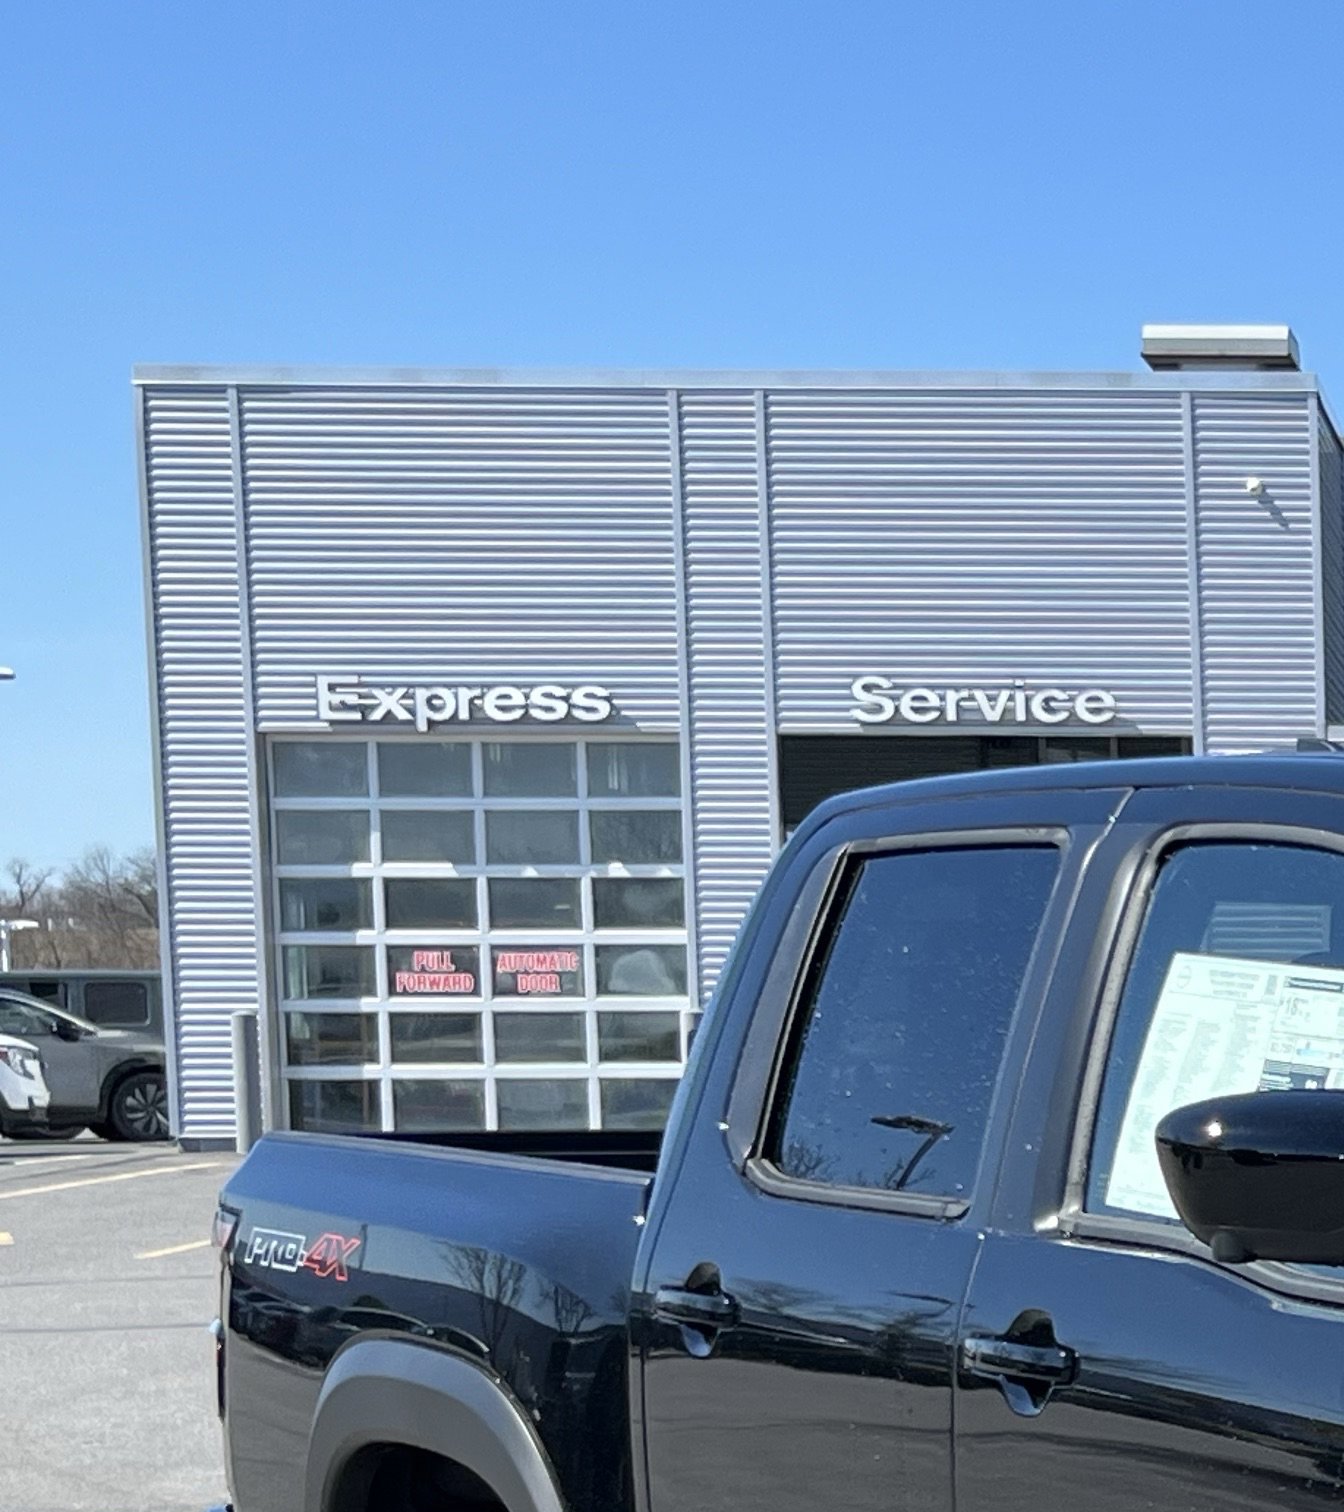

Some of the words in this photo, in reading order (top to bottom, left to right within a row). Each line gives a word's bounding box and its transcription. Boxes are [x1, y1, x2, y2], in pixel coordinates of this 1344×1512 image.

[315, 674, 612, 733] Express
[850, 675, 1117, 723] Service
[413, 950, 455, 972] PULL
[497, 951, 579, 973] AUTOMATIC
[396, 972, 475, 993] FORWARD
[516, 973, 561, 993] DOOR
